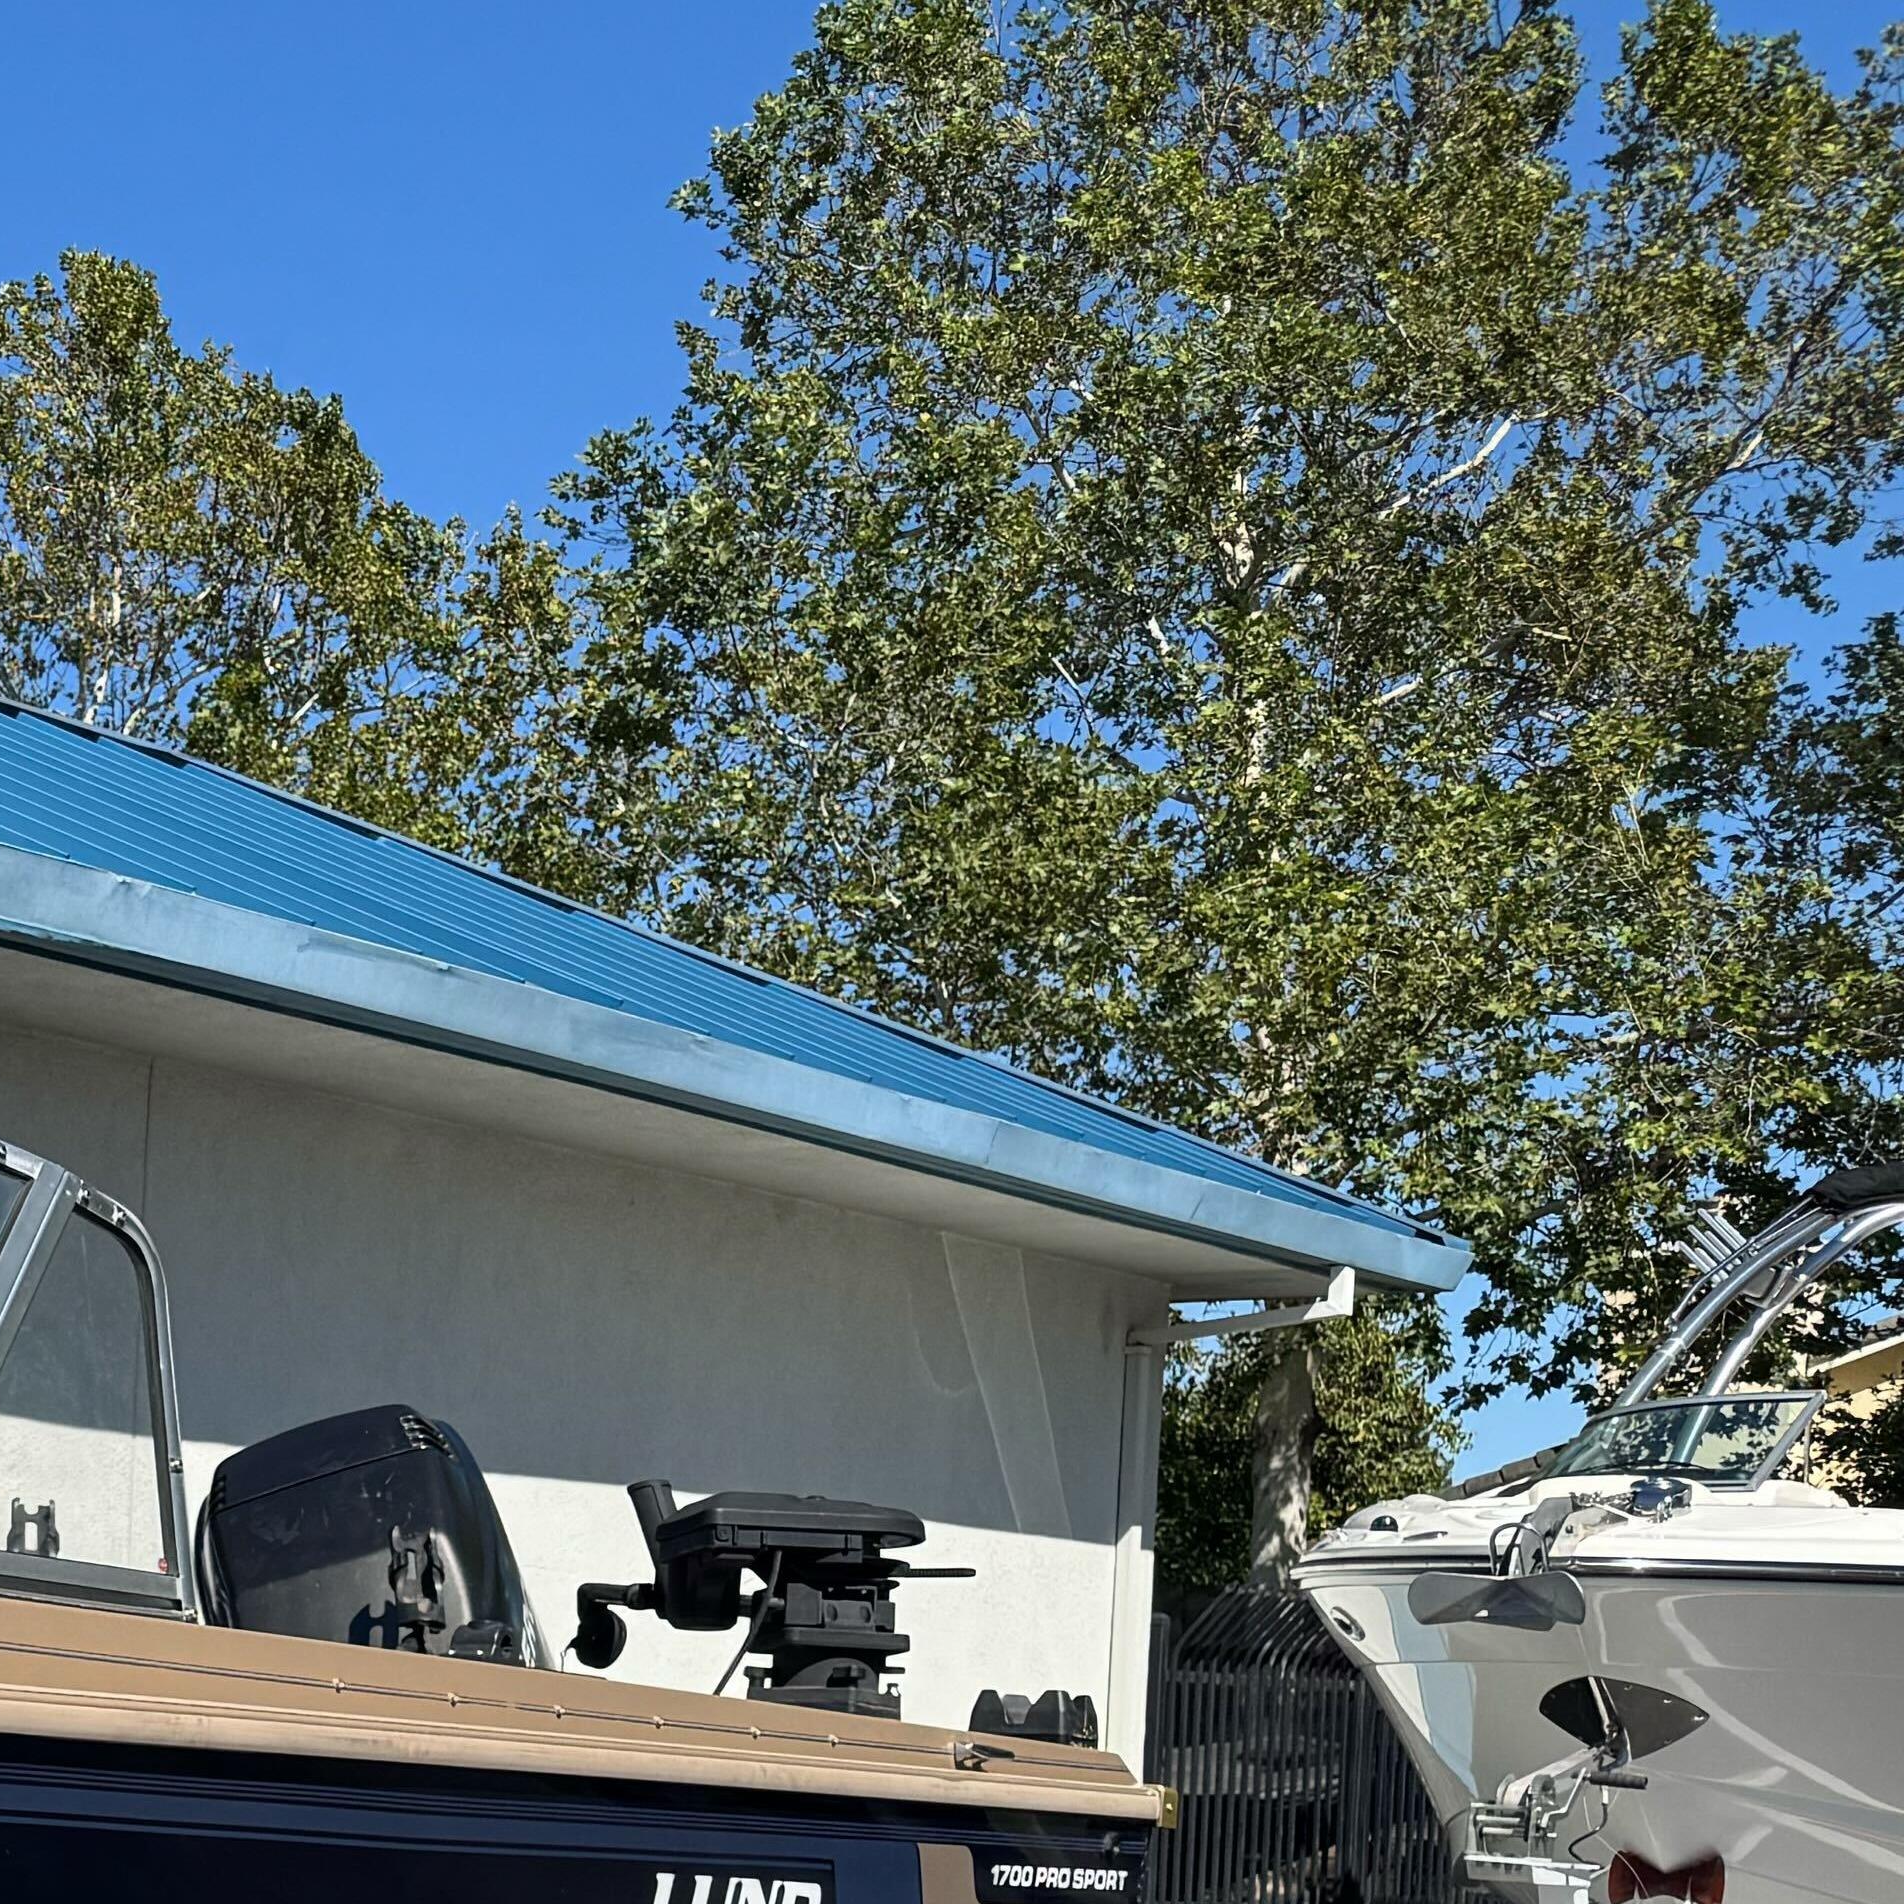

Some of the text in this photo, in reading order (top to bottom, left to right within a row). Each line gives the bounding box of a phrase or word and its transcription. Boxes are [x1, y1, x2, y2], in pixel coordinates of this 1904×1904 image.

[990, 1864, 1129, 1891] 1700 PRO SPORT
